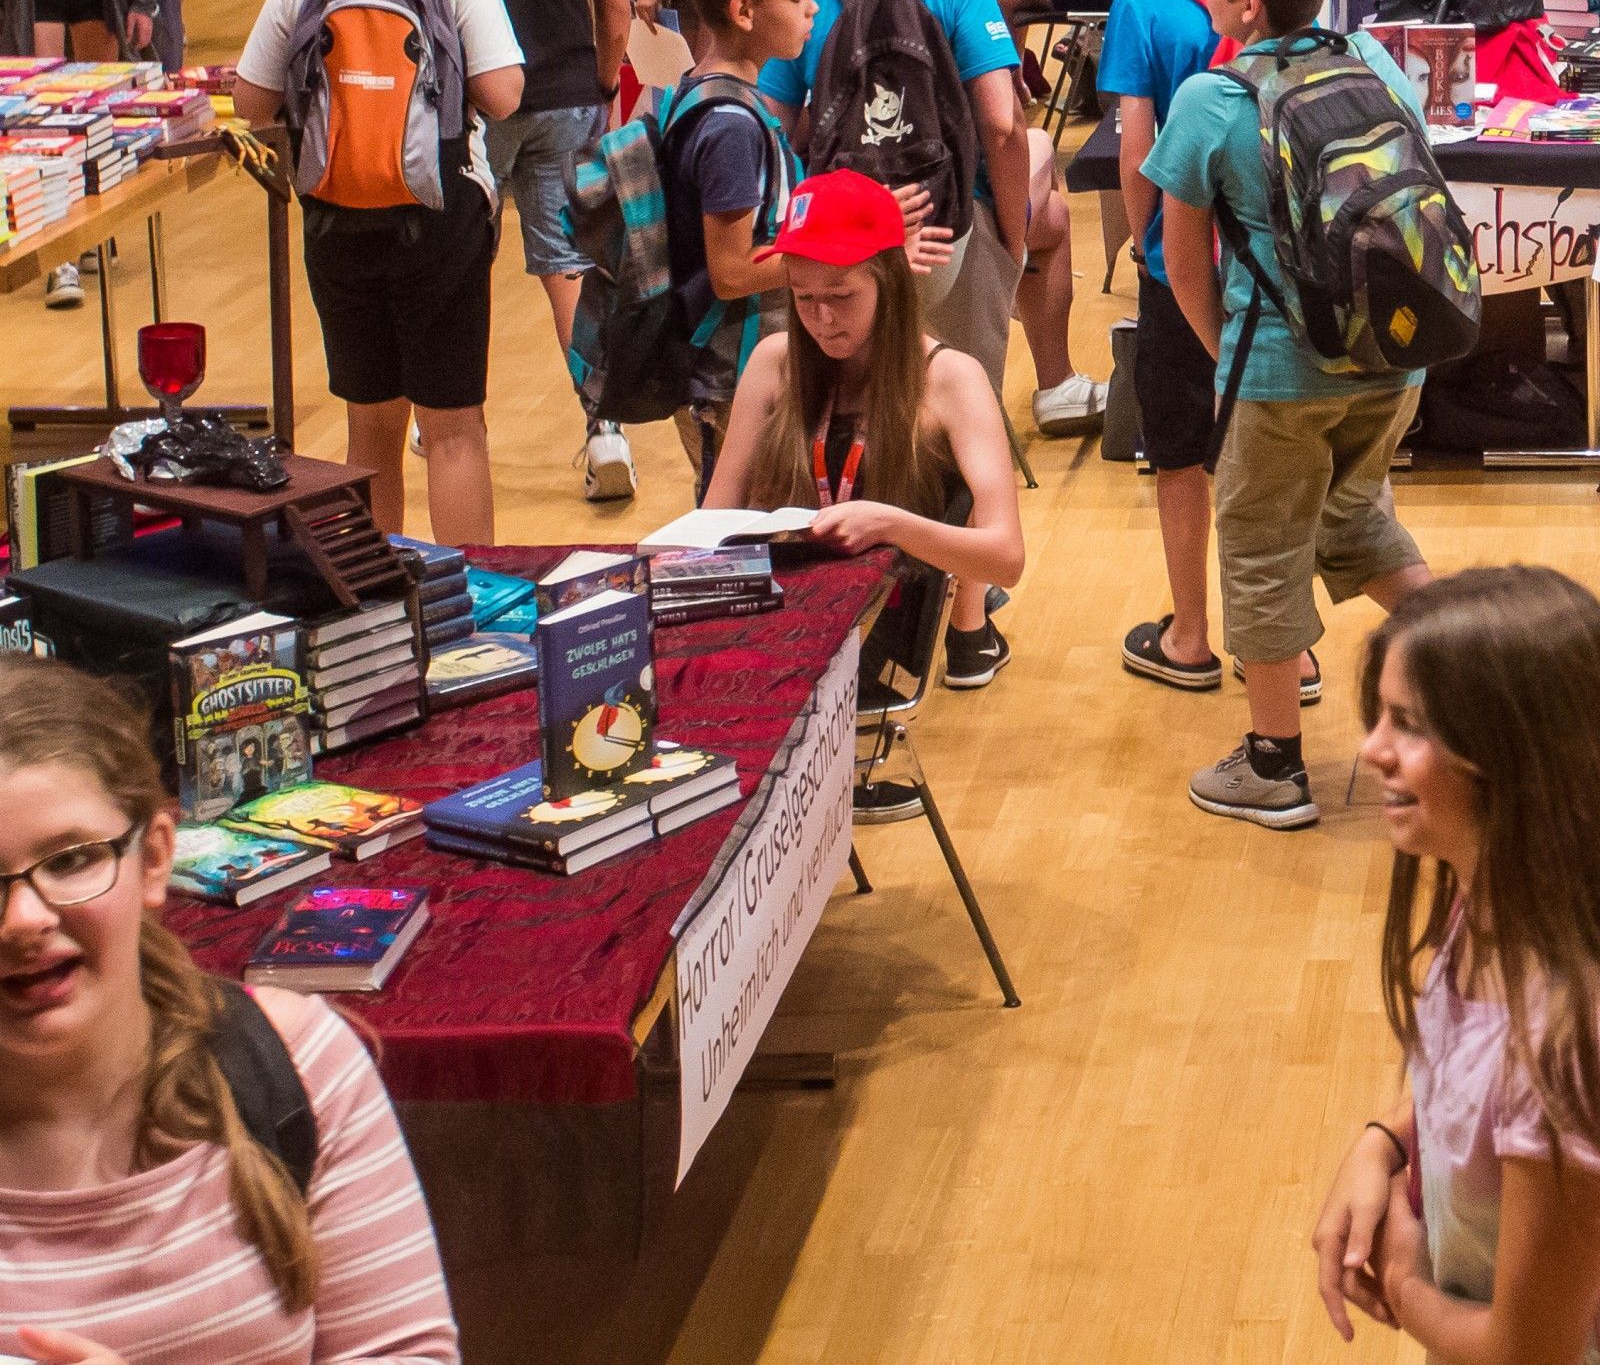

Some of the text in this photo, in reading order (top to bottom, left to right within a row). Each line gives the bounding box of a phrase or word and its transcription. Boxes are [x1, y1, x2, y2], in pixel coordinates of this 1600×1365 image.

[1430, 105, 1453, 115] LIES
[201, 676, 293, 714] GHOSTSITTER
[678, 894, 735, 1039] Horror
[743, 674, 859, 917] Gruselgeschichte
[701, 923, 779, 1102] Unheimlich
